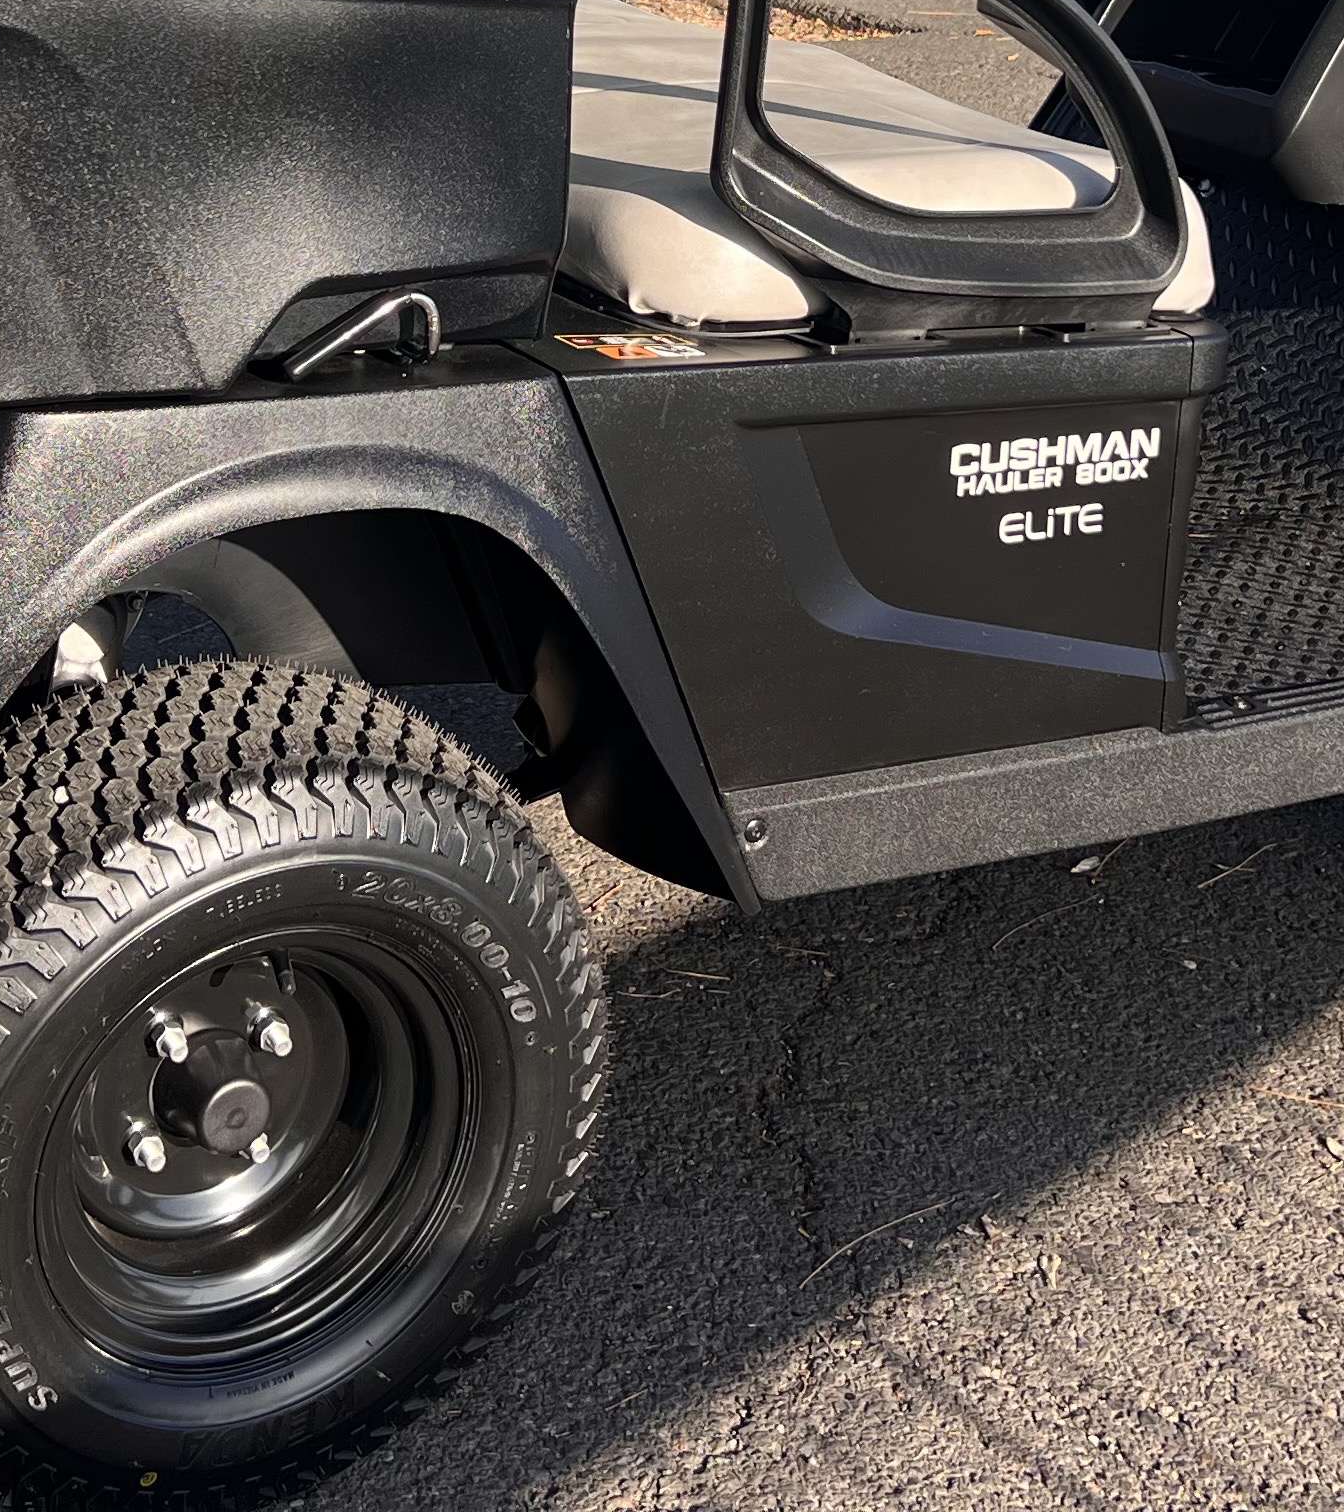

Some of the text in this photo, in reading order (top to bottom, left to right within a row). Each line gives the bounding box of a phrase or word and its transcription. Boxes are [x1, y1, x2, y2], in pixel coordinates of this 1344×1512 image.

[949, 427, 1161, 476] CUSHMAN
[956, 457, 1149, 498] HAULER 800X
